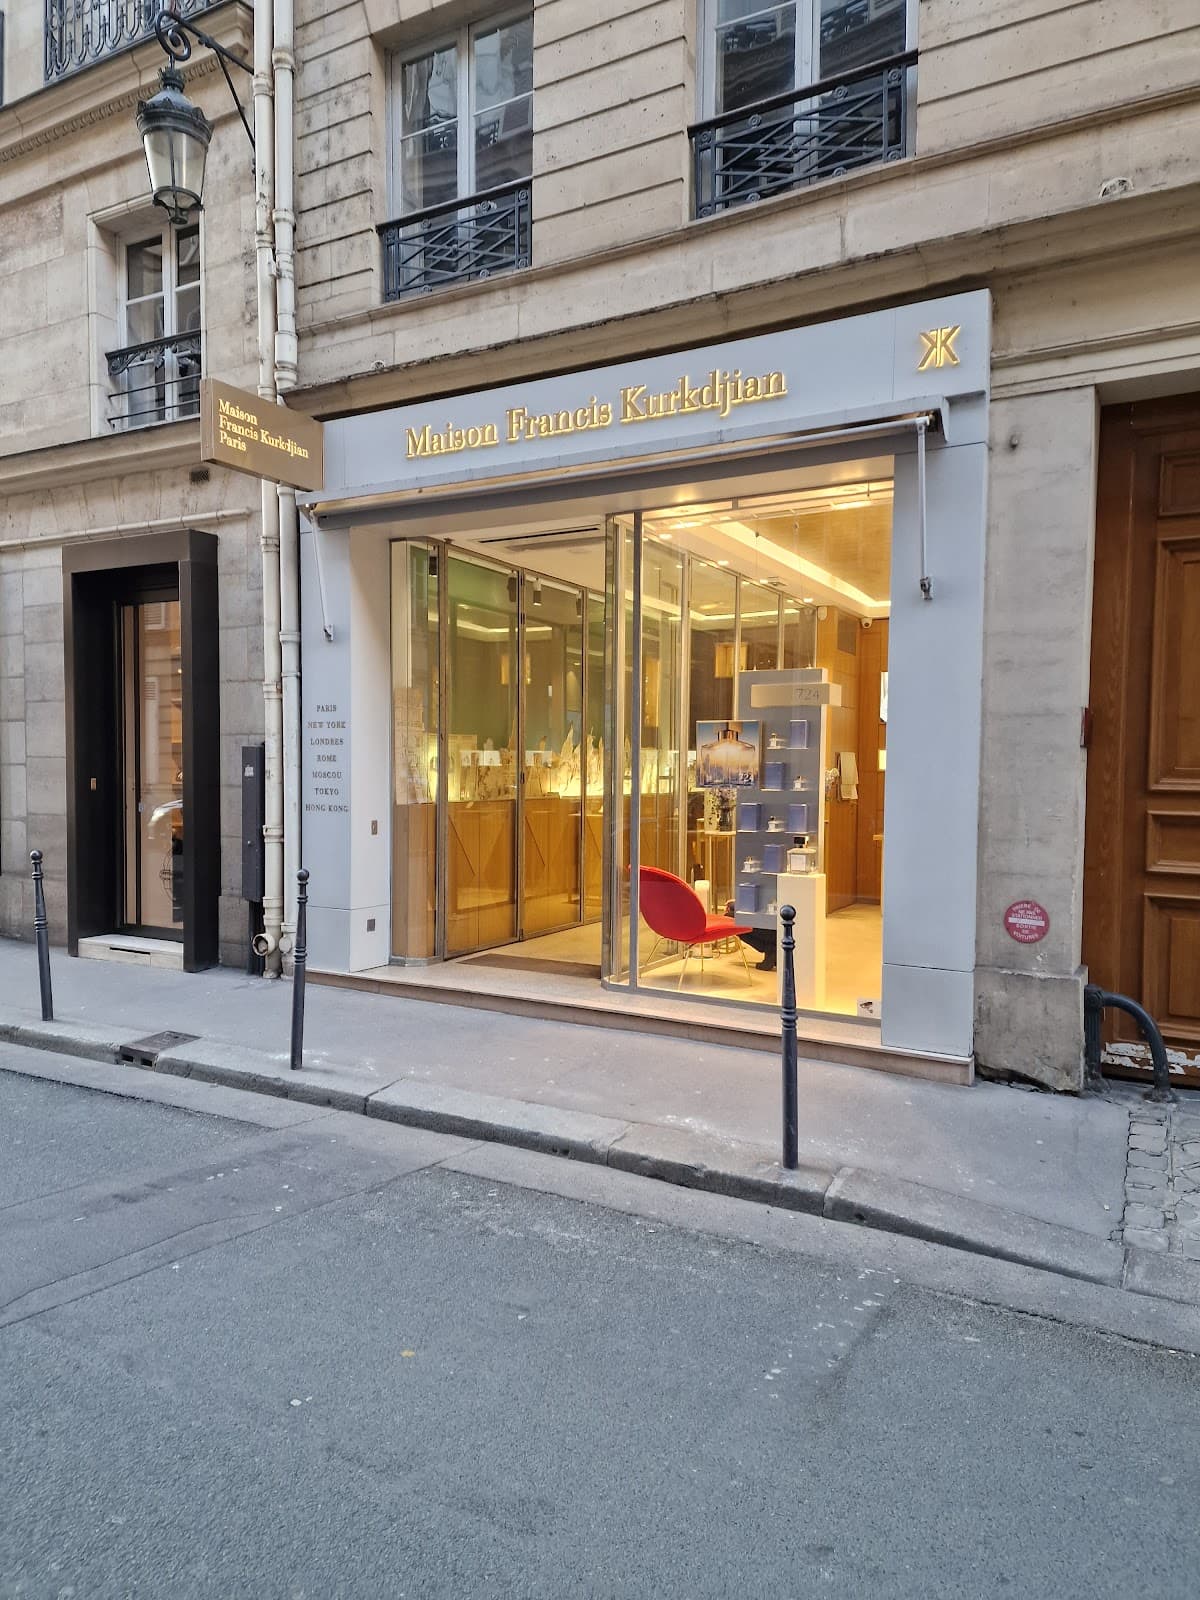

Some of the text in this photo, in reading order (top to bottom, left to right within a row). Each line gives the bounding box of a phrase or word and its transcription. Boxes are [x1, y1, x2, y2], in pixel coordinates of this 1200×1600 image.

[218, 398, 258, 426] Maison
[405, 368, 788, 459] Maison Francis Kurkdjian
[218, 415, 309, 458] Francis Kurkdjian
[219, 430, 247, 452] Paris
[316, 704, 337, 713] PARIS
[307, 721, 347, 729] NEW YORK
[310, 738, 344, 746] LONDRES
[316, 754, 337, 762] ROME
[312, 771, 342, 779] MOSCOU
[314, 787, 339, 796] TOKYO
[305, 804, 349, 813] HONG KONG
